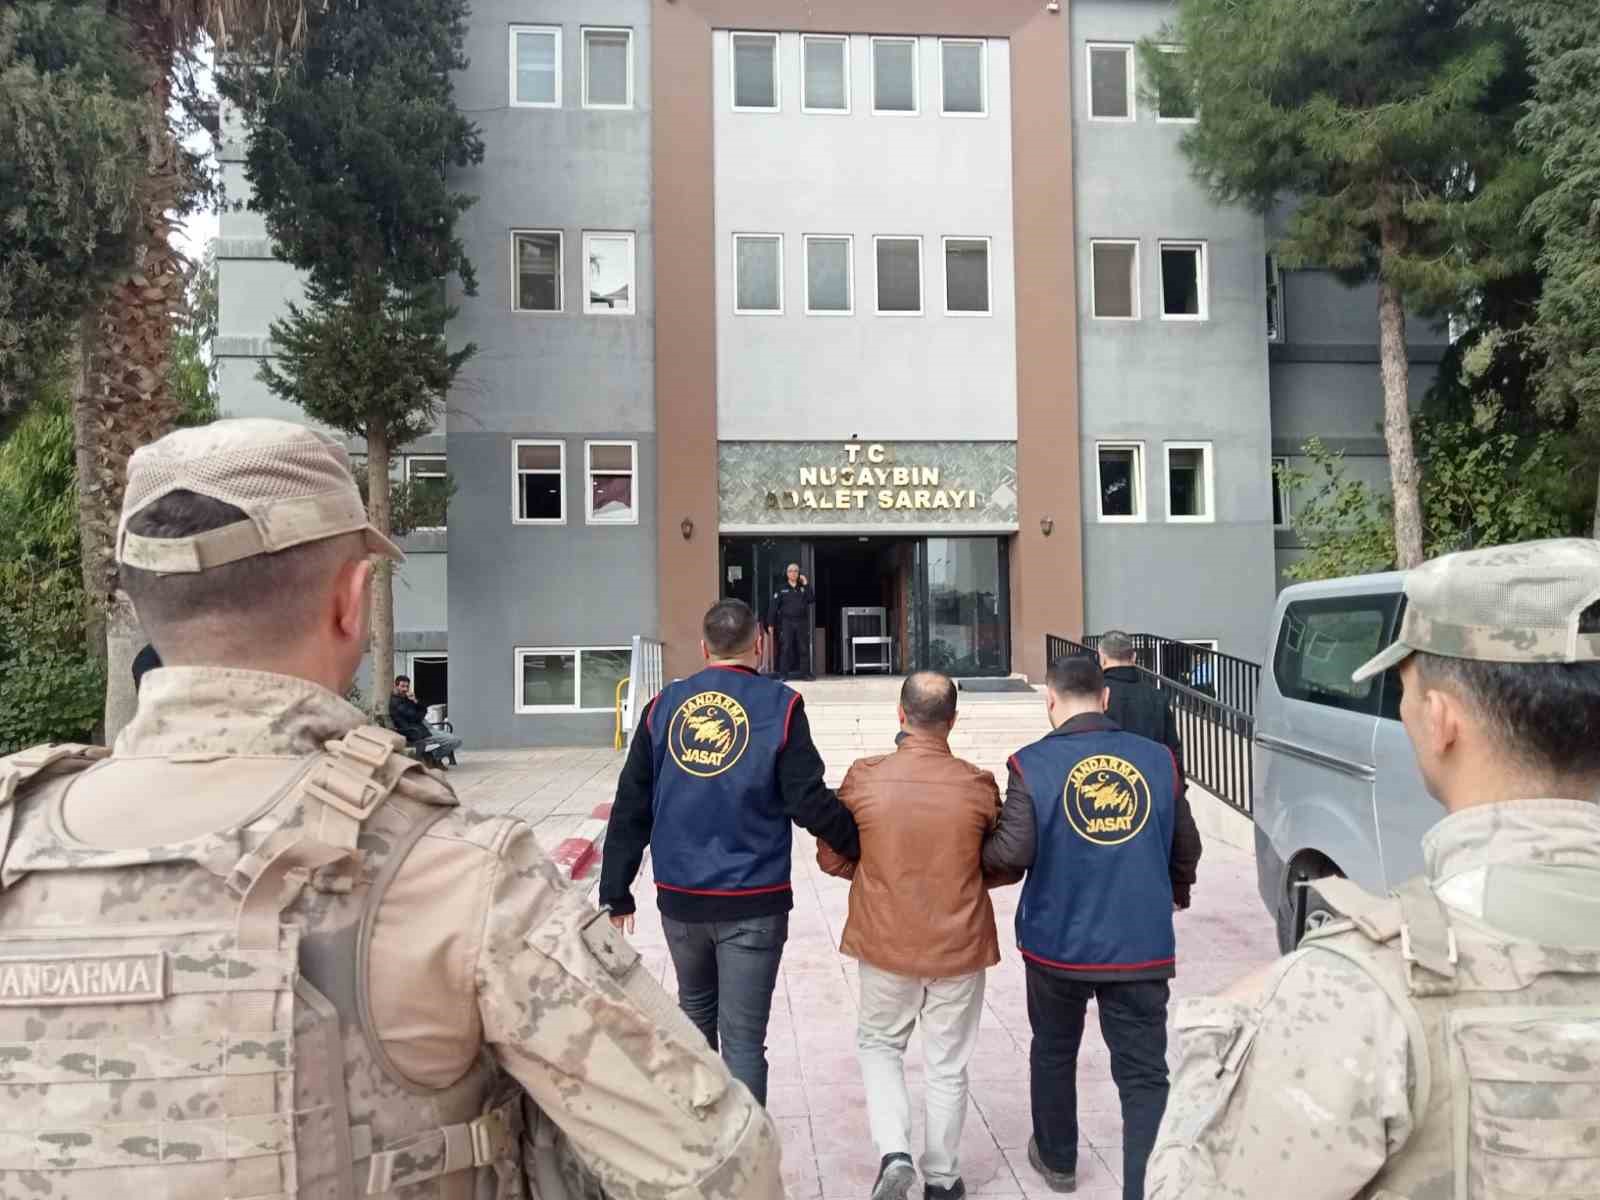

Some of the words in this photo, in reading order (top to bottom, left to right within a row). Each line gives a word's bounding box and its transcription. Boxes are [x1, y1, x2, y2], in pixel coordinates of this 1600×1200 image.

[878, 489, 976, 508] SARAYI
[682, 694, 746, 726] JANDARMA
[681, 748, 724, 767] JASAT
[1070, 758, 1139, 788] JANDARMA
[1086, 815, 1133, 833] JASAT
[0, 960, 151, 997] ANDARMA
